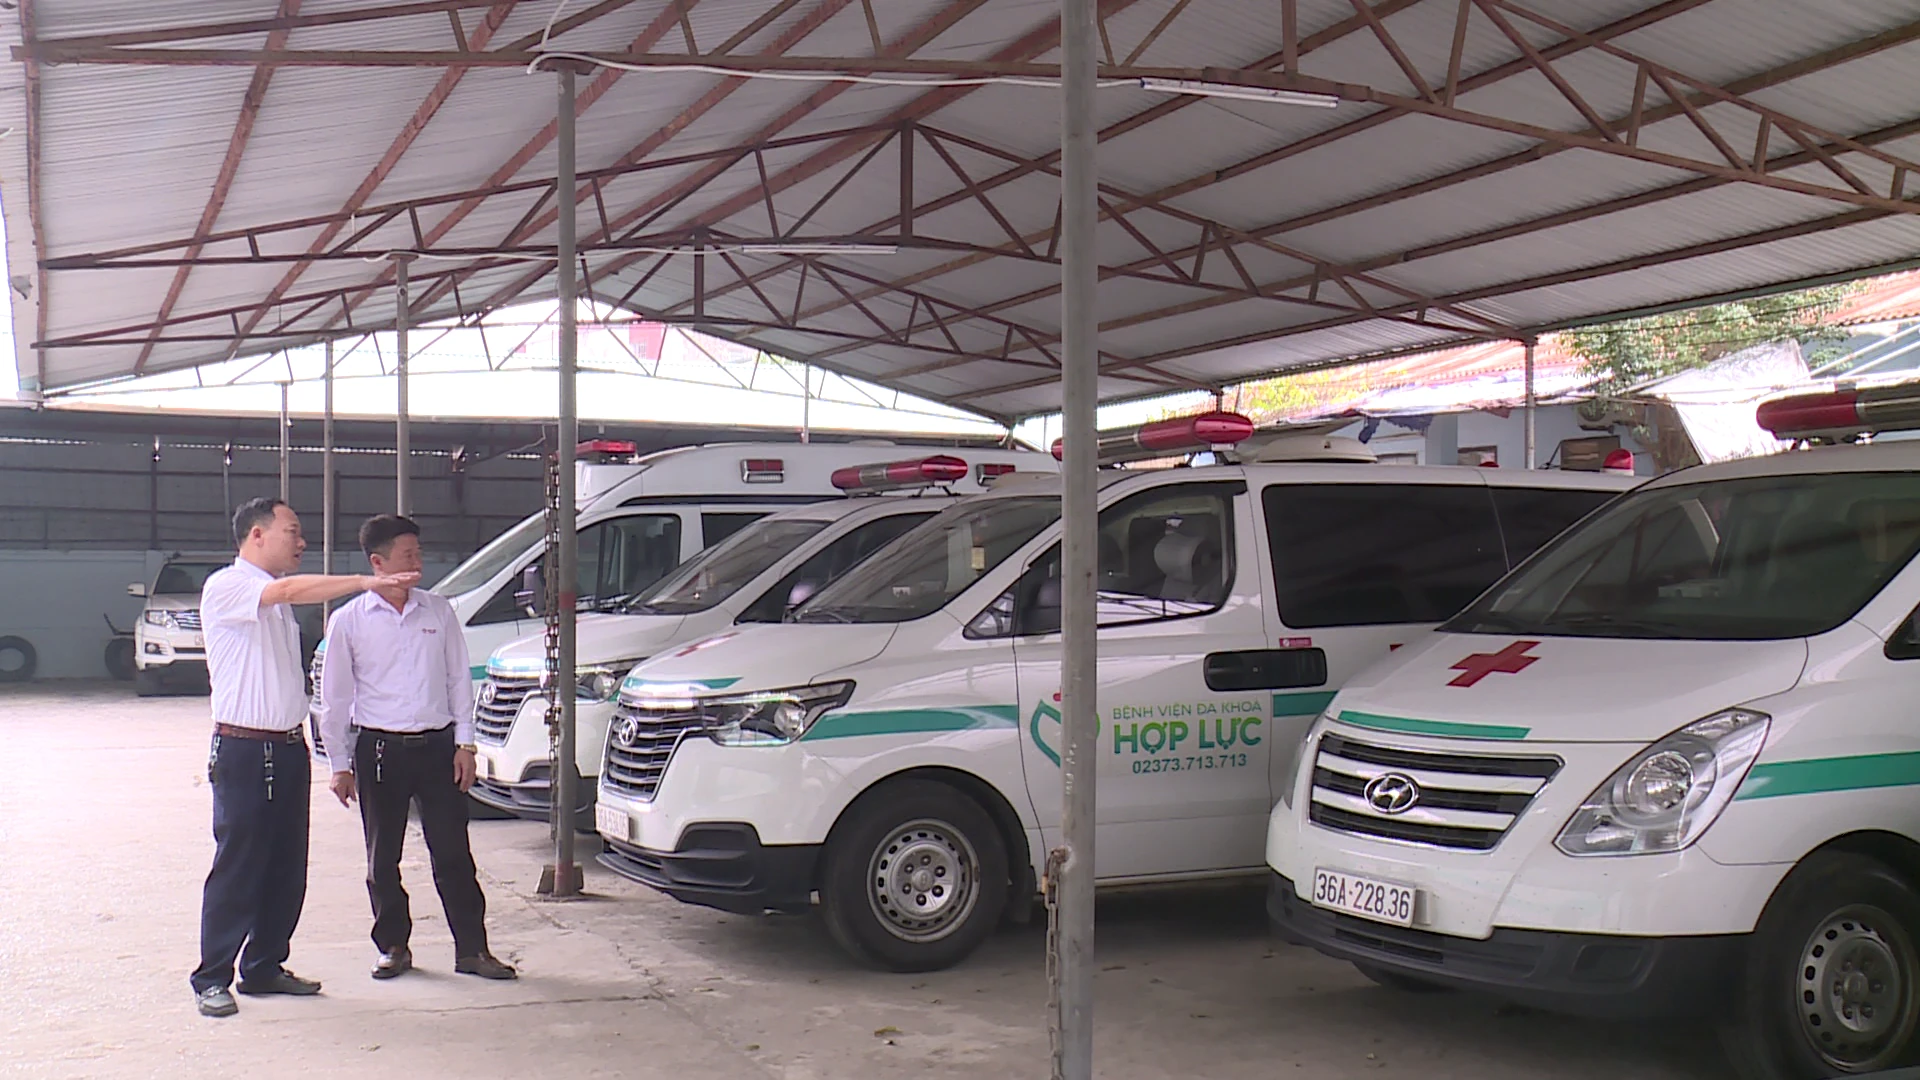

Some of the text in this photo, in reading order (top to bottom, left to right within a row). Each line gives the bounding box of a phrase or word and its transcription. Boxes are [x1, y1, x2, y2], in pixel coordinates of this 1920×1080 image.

[1113, 701, 1262, 721] BỆNH VIỆN ĐA KHOA
[1114, 717, 1262, 754] HỢP LỰC
[1132, 754, 1247, 774] 02373.713.713
[1316, 873, 1411, 919] 36A-228.36
